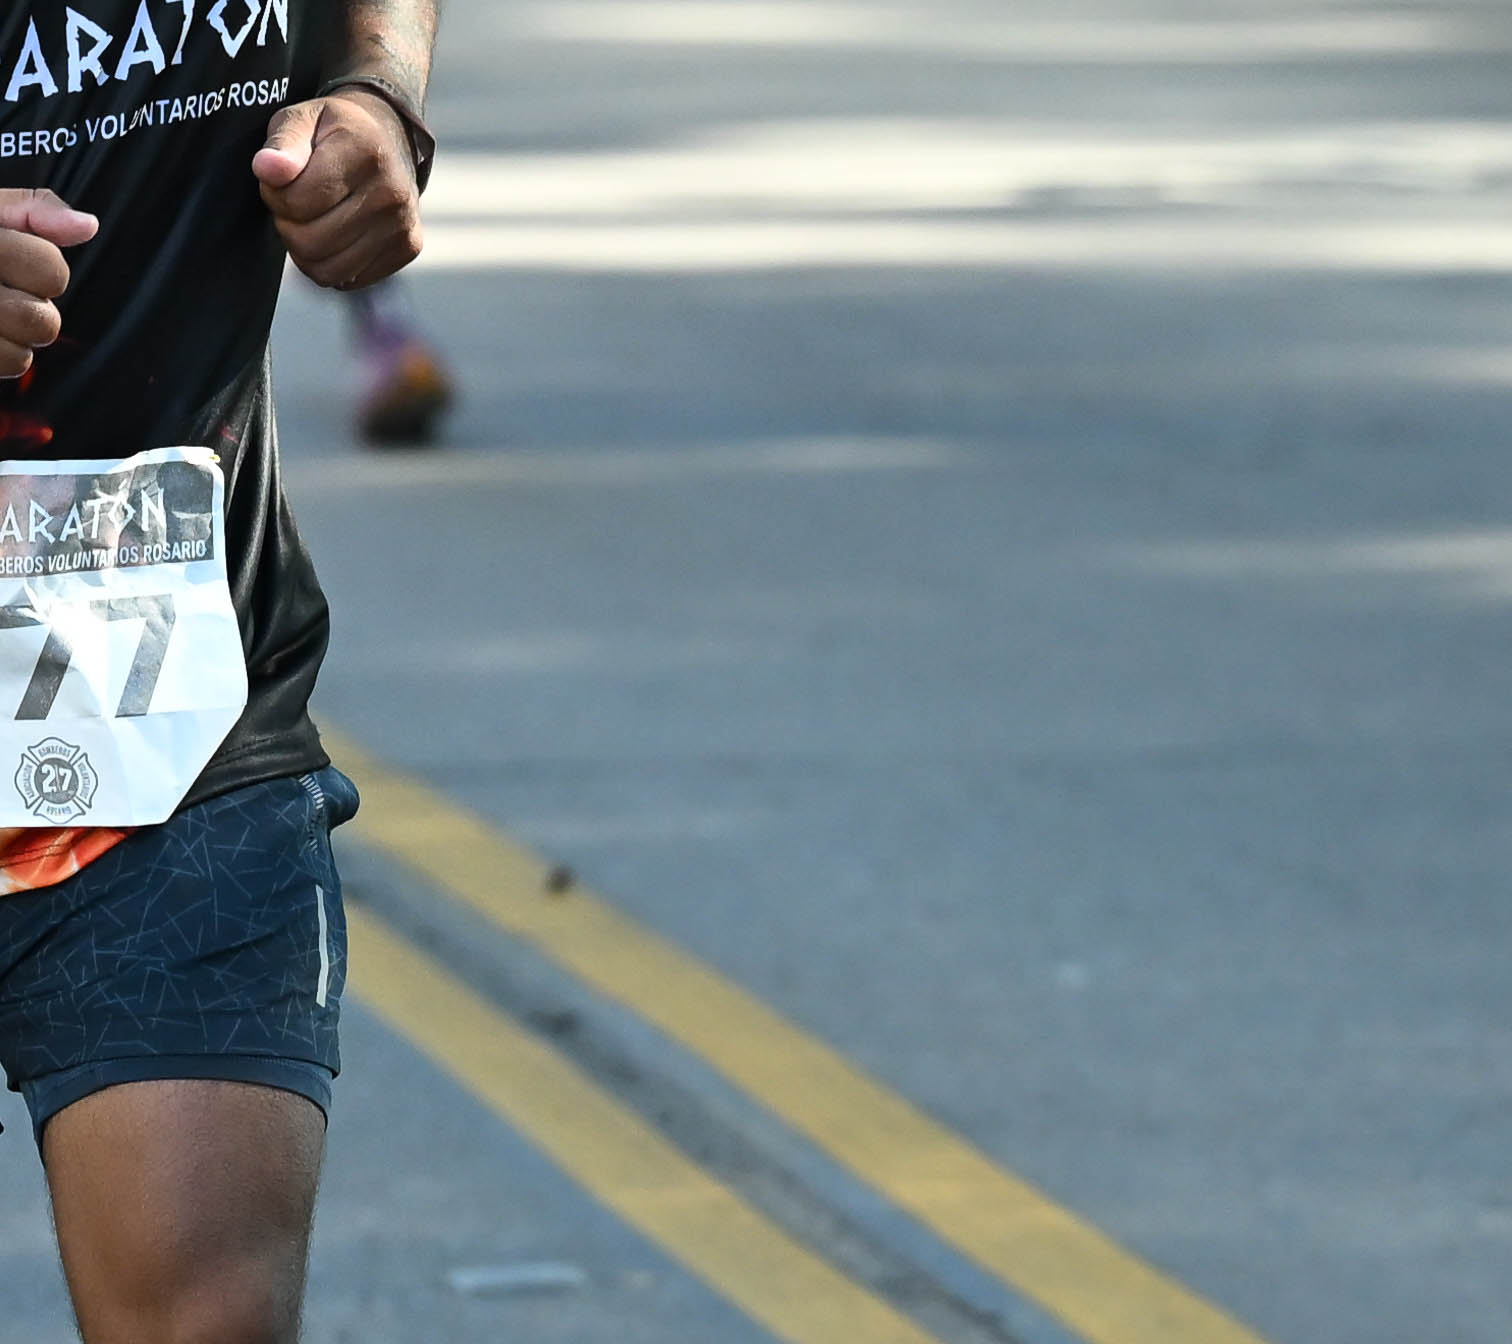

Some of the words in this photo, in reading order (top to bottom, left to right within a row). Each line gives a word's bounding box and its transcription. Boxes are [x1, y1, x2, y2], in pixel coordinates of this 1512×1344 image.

[85, 87, 226, 143] VOLUNTARIOS
[227, 76, 290, 108] ROSAR
[142, 538, 208, 563] ROSARIO
[41, 764, 73, 794] 27
